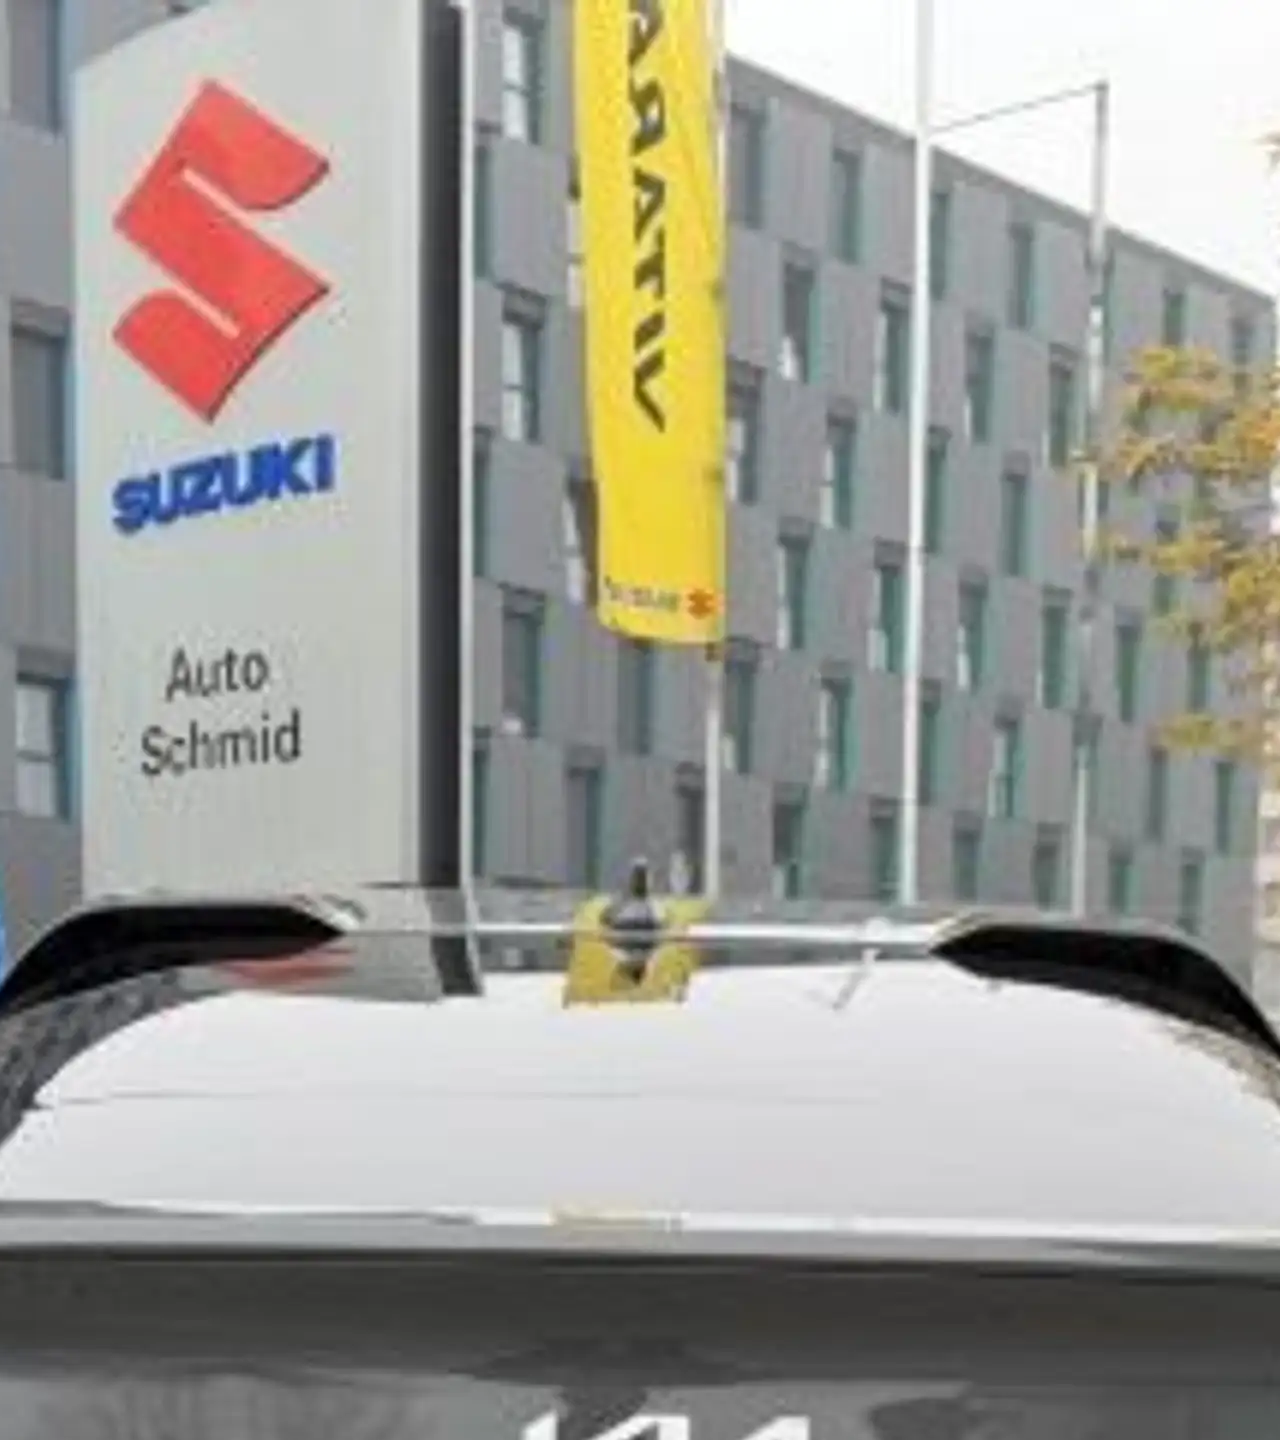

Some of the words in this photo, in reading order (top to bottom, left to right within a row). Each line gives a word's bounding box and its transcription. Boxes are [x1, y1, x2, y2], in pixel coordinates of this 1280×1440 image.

[112, 434, 336, 533] SUZUKI
[165, 648, 270, 701] Auto
[141, 706, 302, 776] Schmid
